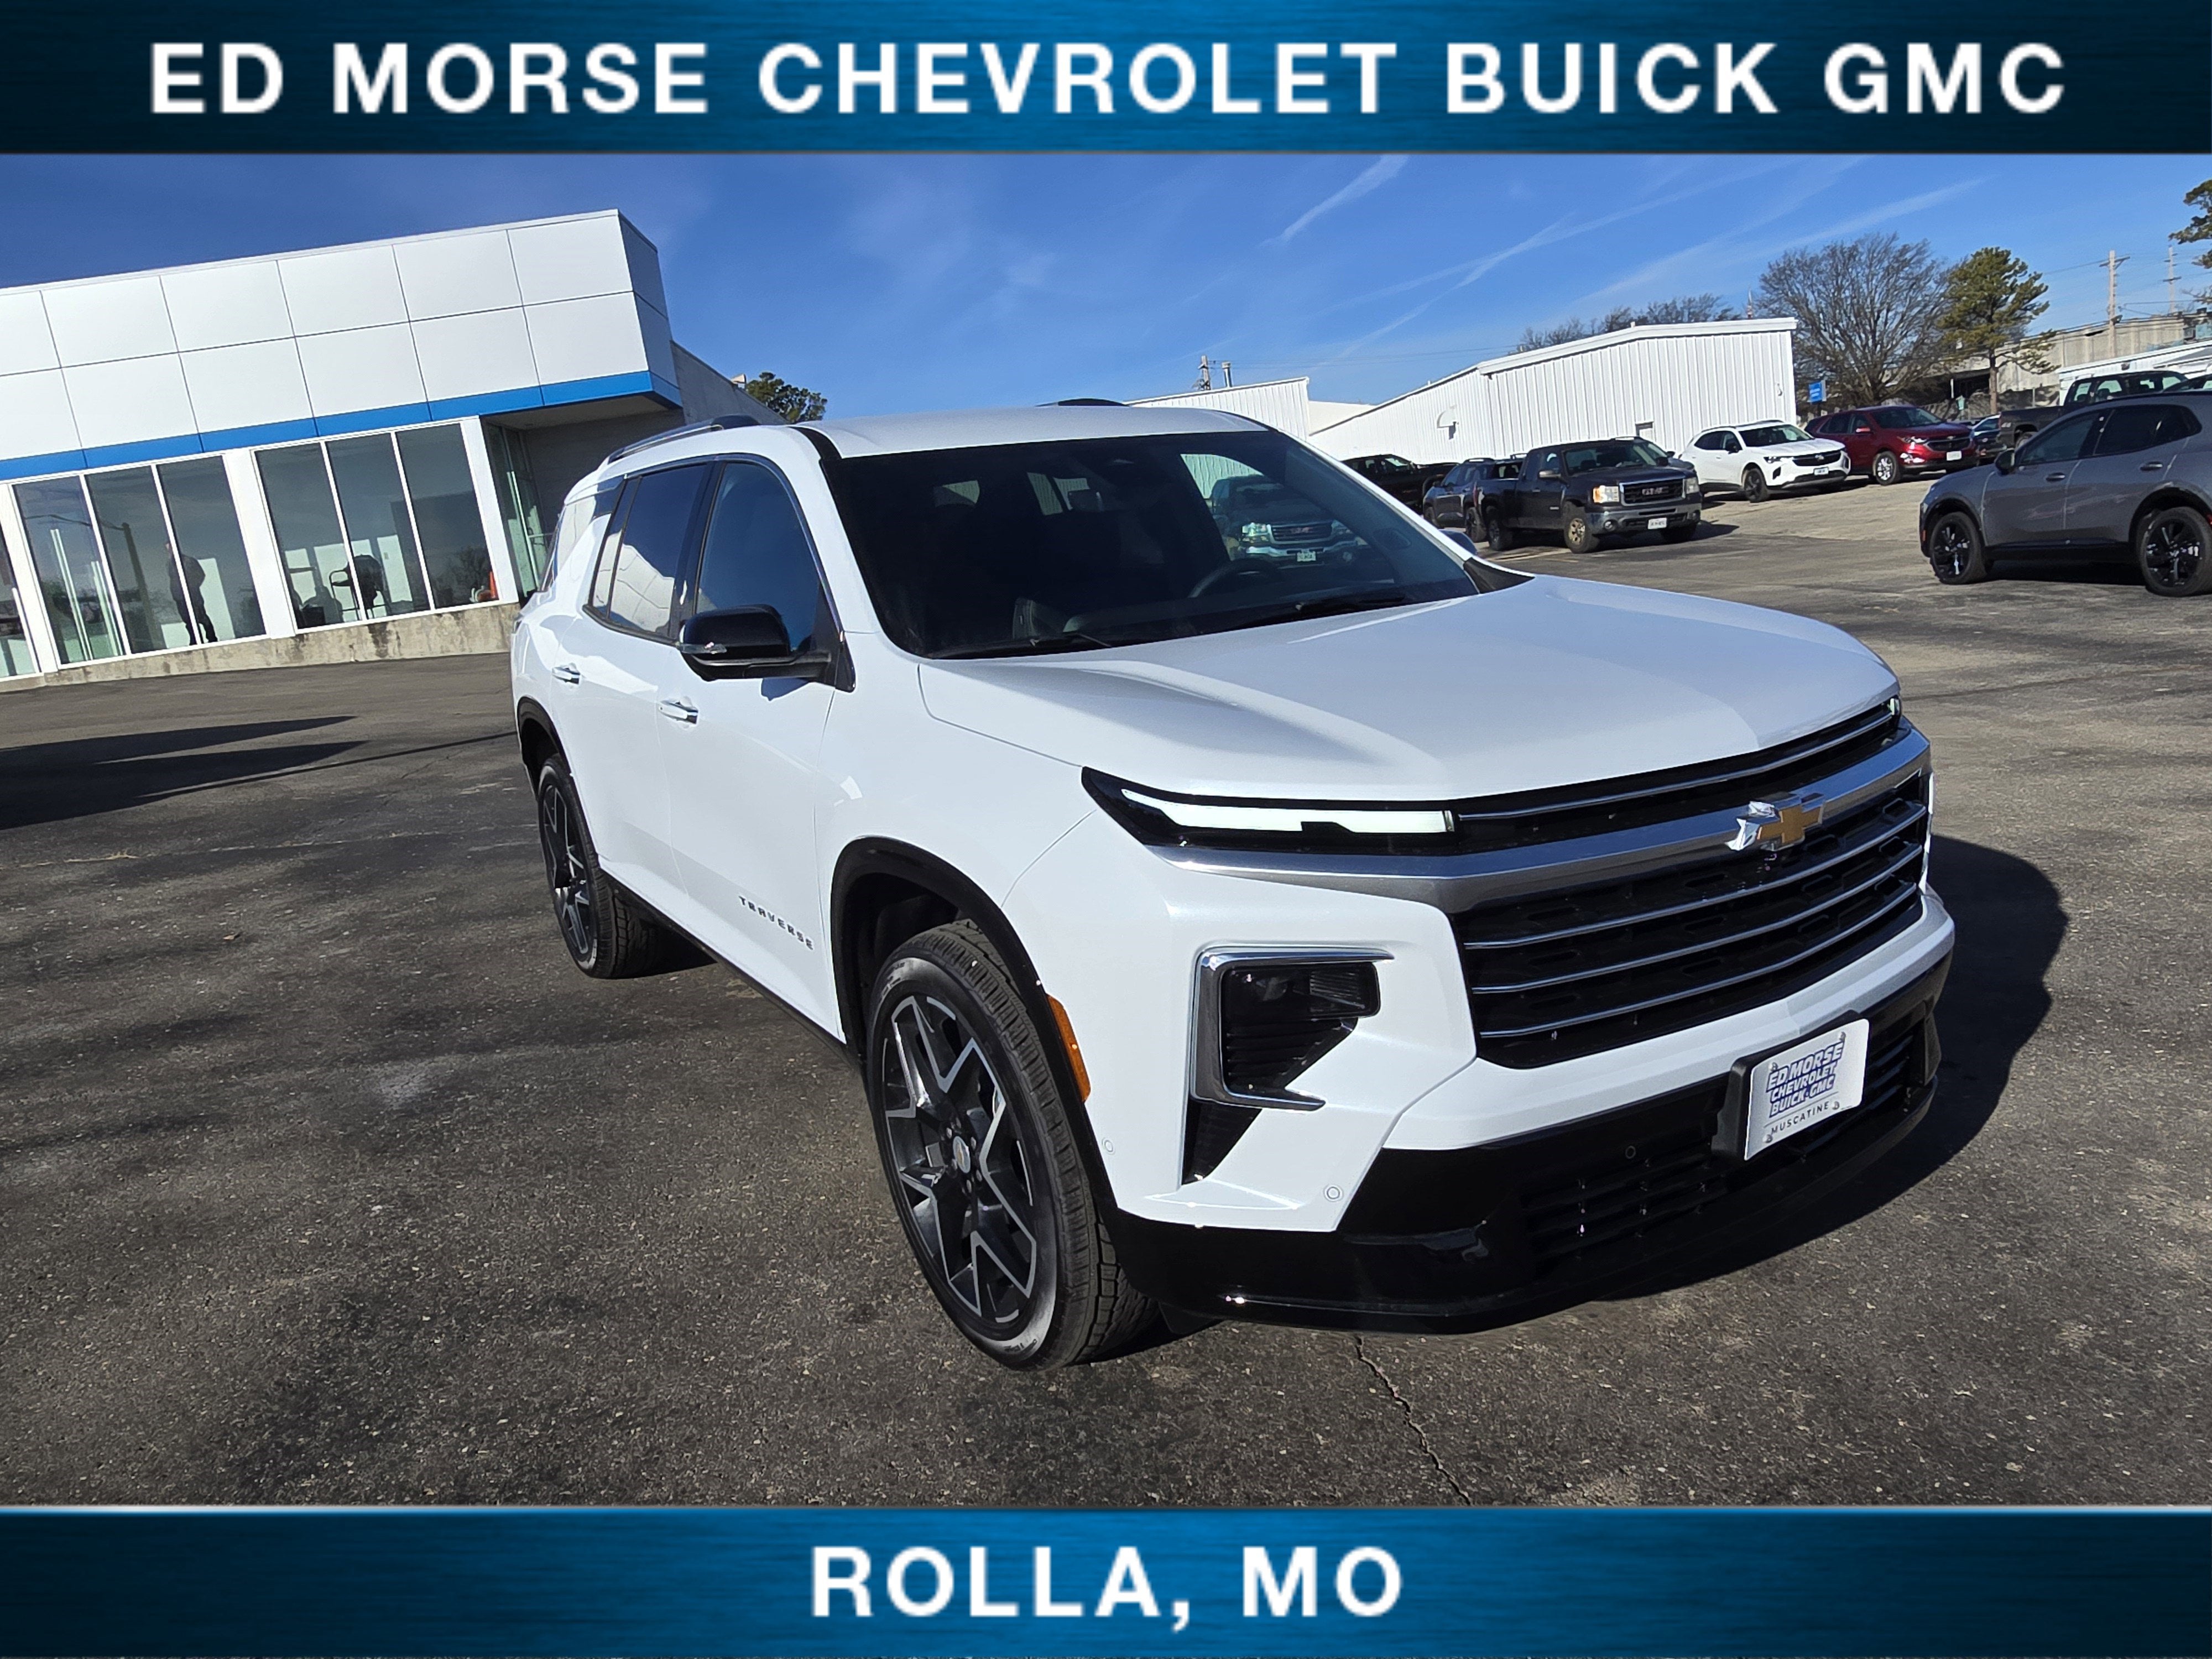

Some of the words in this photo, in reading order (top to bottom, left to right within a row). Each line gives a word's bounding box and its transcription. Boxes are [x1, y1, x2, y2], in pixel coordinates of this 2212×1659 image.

[739, 896, 813, 950] TRAVERSE
[1766, 1066, 1789, 1092] ED
[1788, 1042, 1844, 1081] MORSE
[1770, 1061, 1837, 1102] CHEVROLET
[1771, 1101, 1829, 1134] MUSCATINE
